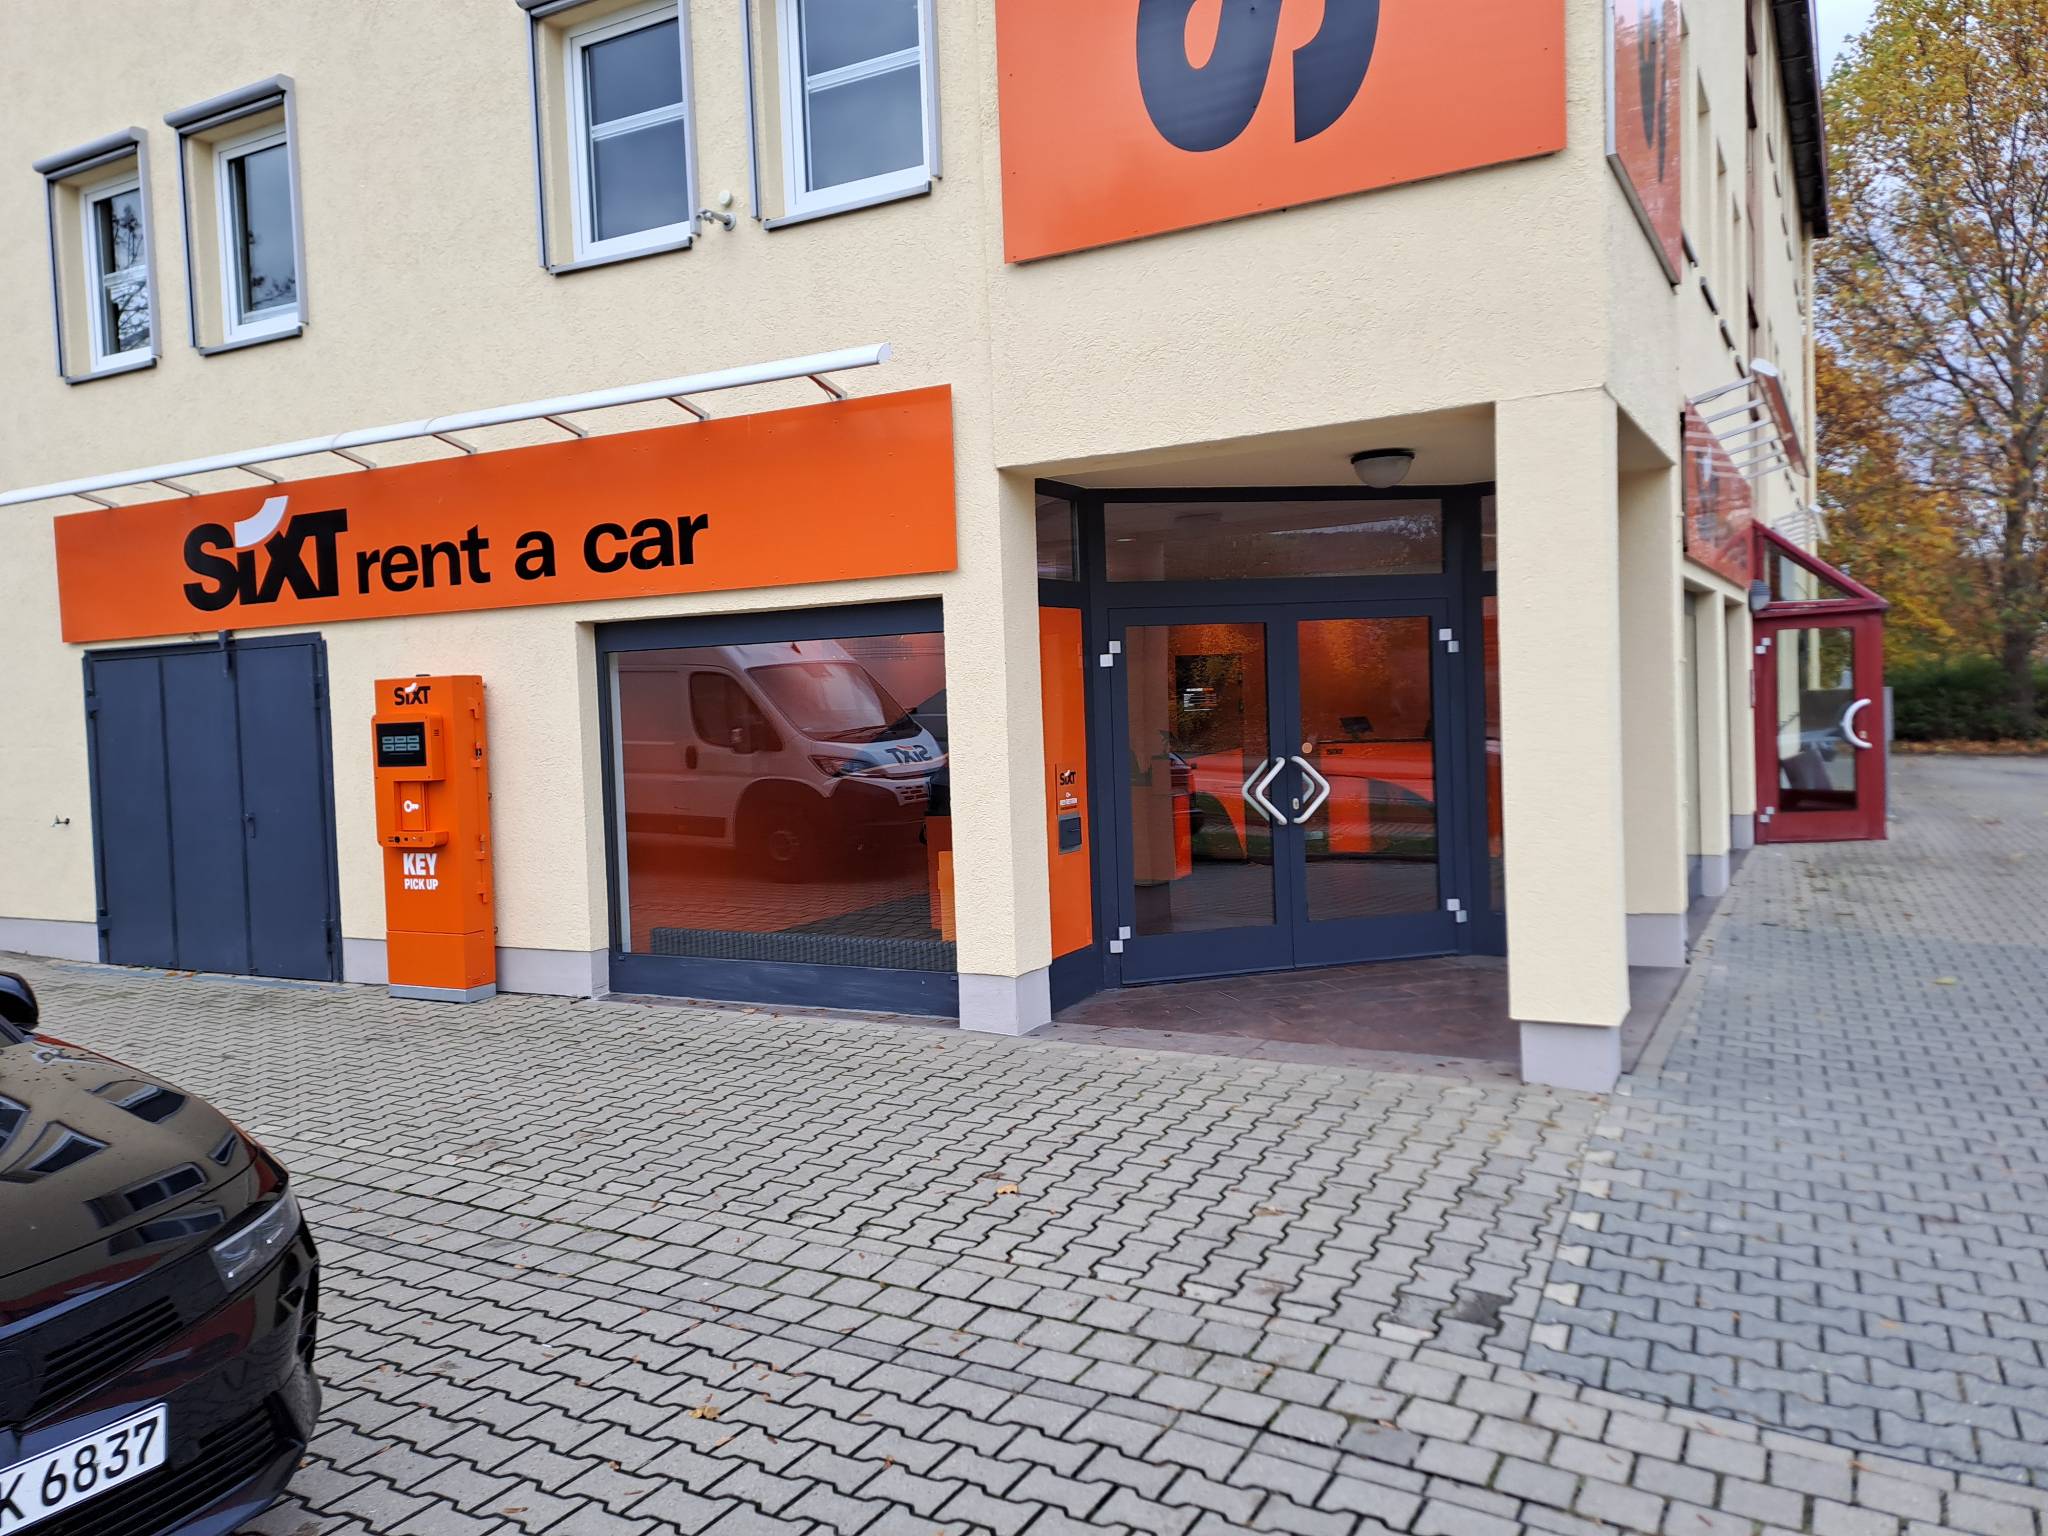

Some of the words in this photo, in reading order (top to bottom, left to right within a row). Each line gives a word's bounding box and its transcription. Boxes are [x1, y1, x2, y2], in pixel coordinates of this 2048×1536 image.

[356, 524, 491, 594] rent
[514, 530, 556, 580] a
[583, 513, 709, 574] car
[403, 853, 437, 876] KEY
[404, 879, 425, 890] PICK
[426, 878, 439, 890] UP
[41, 1416, 160, 1507] 6837
